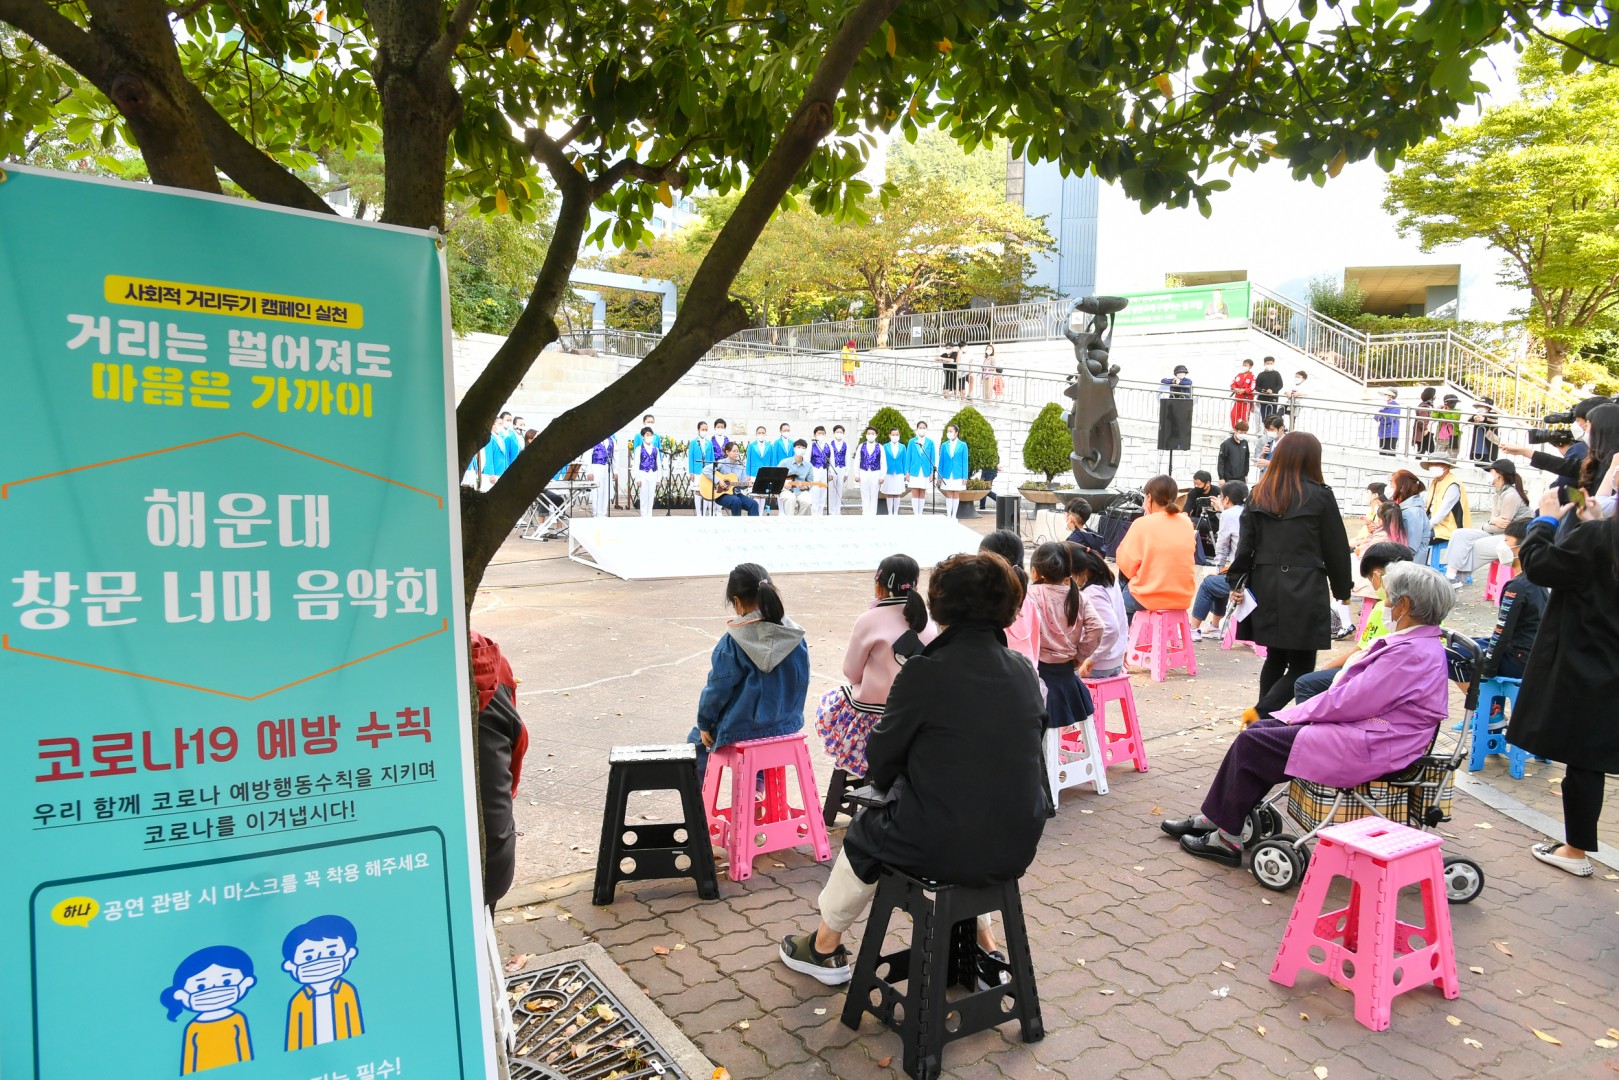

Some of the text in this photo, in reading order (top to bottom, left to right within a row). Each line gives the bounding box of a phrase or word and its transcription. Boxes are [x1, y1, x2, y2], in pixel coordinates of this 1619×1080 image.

[124, 283, 348, 323] 사회적 거리두기 캠페인 실천
[66, 313, 393, 378] 거리는 멀어져도
[91, 362, 373, 418] 마음은 가까이
[143, 488, 331, 549] 해운대
[11, 566, 438, 630] 창문 너머 음악회
[35, 706, 433, 782] 코로나19 예방 수칙
[33, 760, 437, 825] 우리 함께 코로나 예방행동수칙을 지키며
[144, 800, 357, 845] 코로나를 이겨냅시다!
[62, 902, 92, 920] 하나
[103, 852, 430, 922] 공연 관람 시 마스크를 꼭 착용 해주세요
[356, 1057, 401, 1080] 필수!
